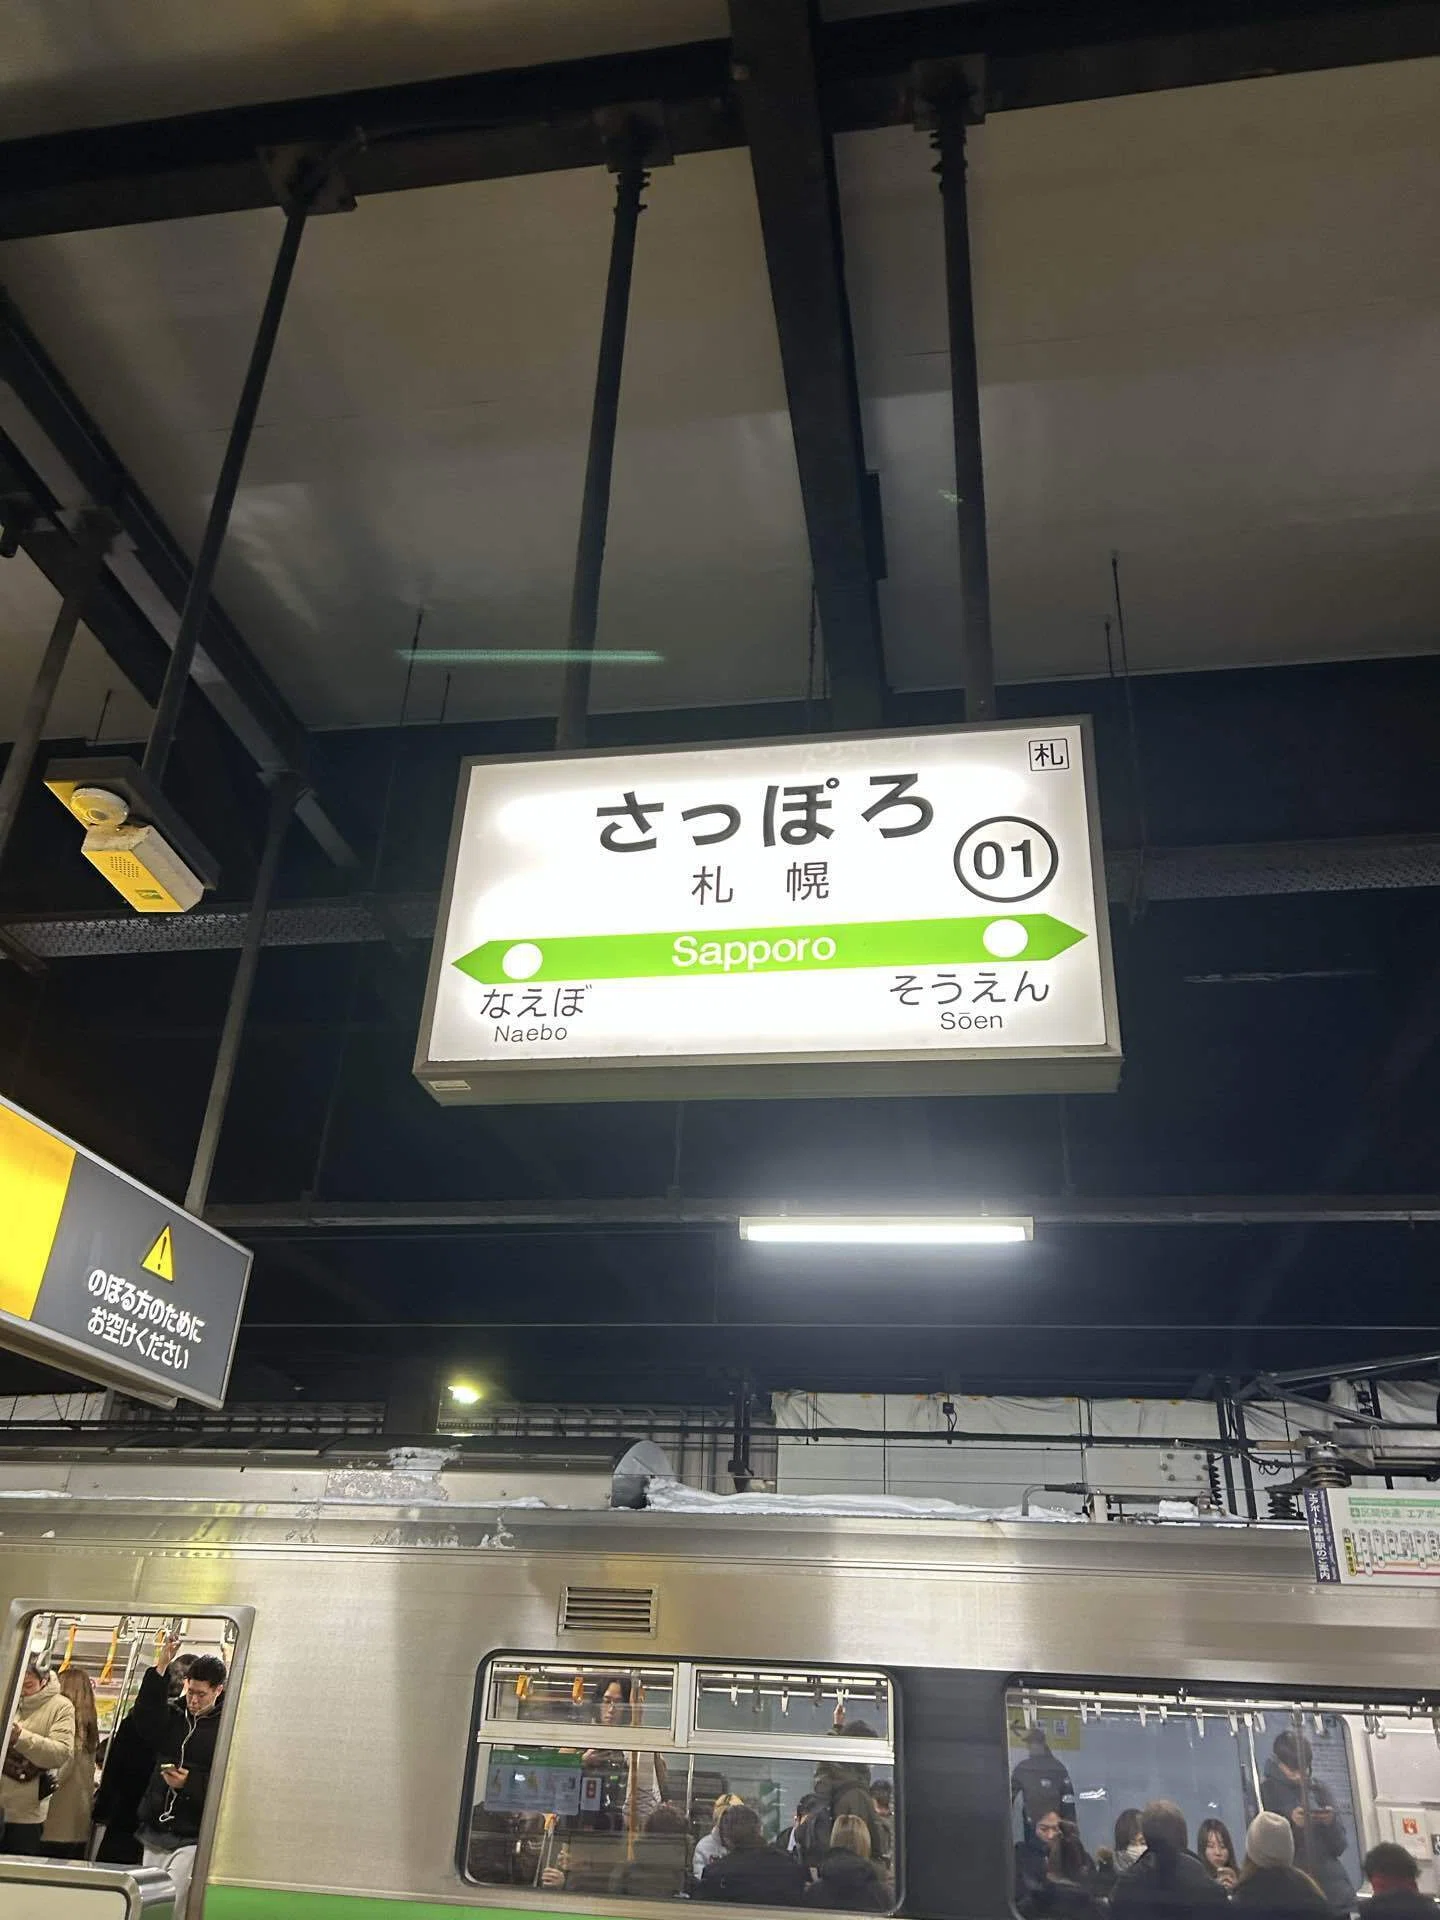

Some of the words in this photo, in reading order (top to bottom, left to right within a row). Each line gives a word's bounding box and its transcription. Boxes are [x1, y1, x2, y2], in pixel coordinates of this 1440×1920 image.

[1034, 742, 1064, 767] 札
[596, 773, 934, 853] さっぽろ
[972, 839, 1034, 881] 01
[671, 935, 837, 971] Sapporo
[480, 984, 592, 1019] なえぼ
[889, 970, 1049, 1006] そうえん
[494, 1023, 568, 1043] Naebo
[940, 1011, 1003, 1031] Sōen
[88, 1269, 205, 1343] のぼる方のために
[88, 1306, 189, 1369] お空けください
